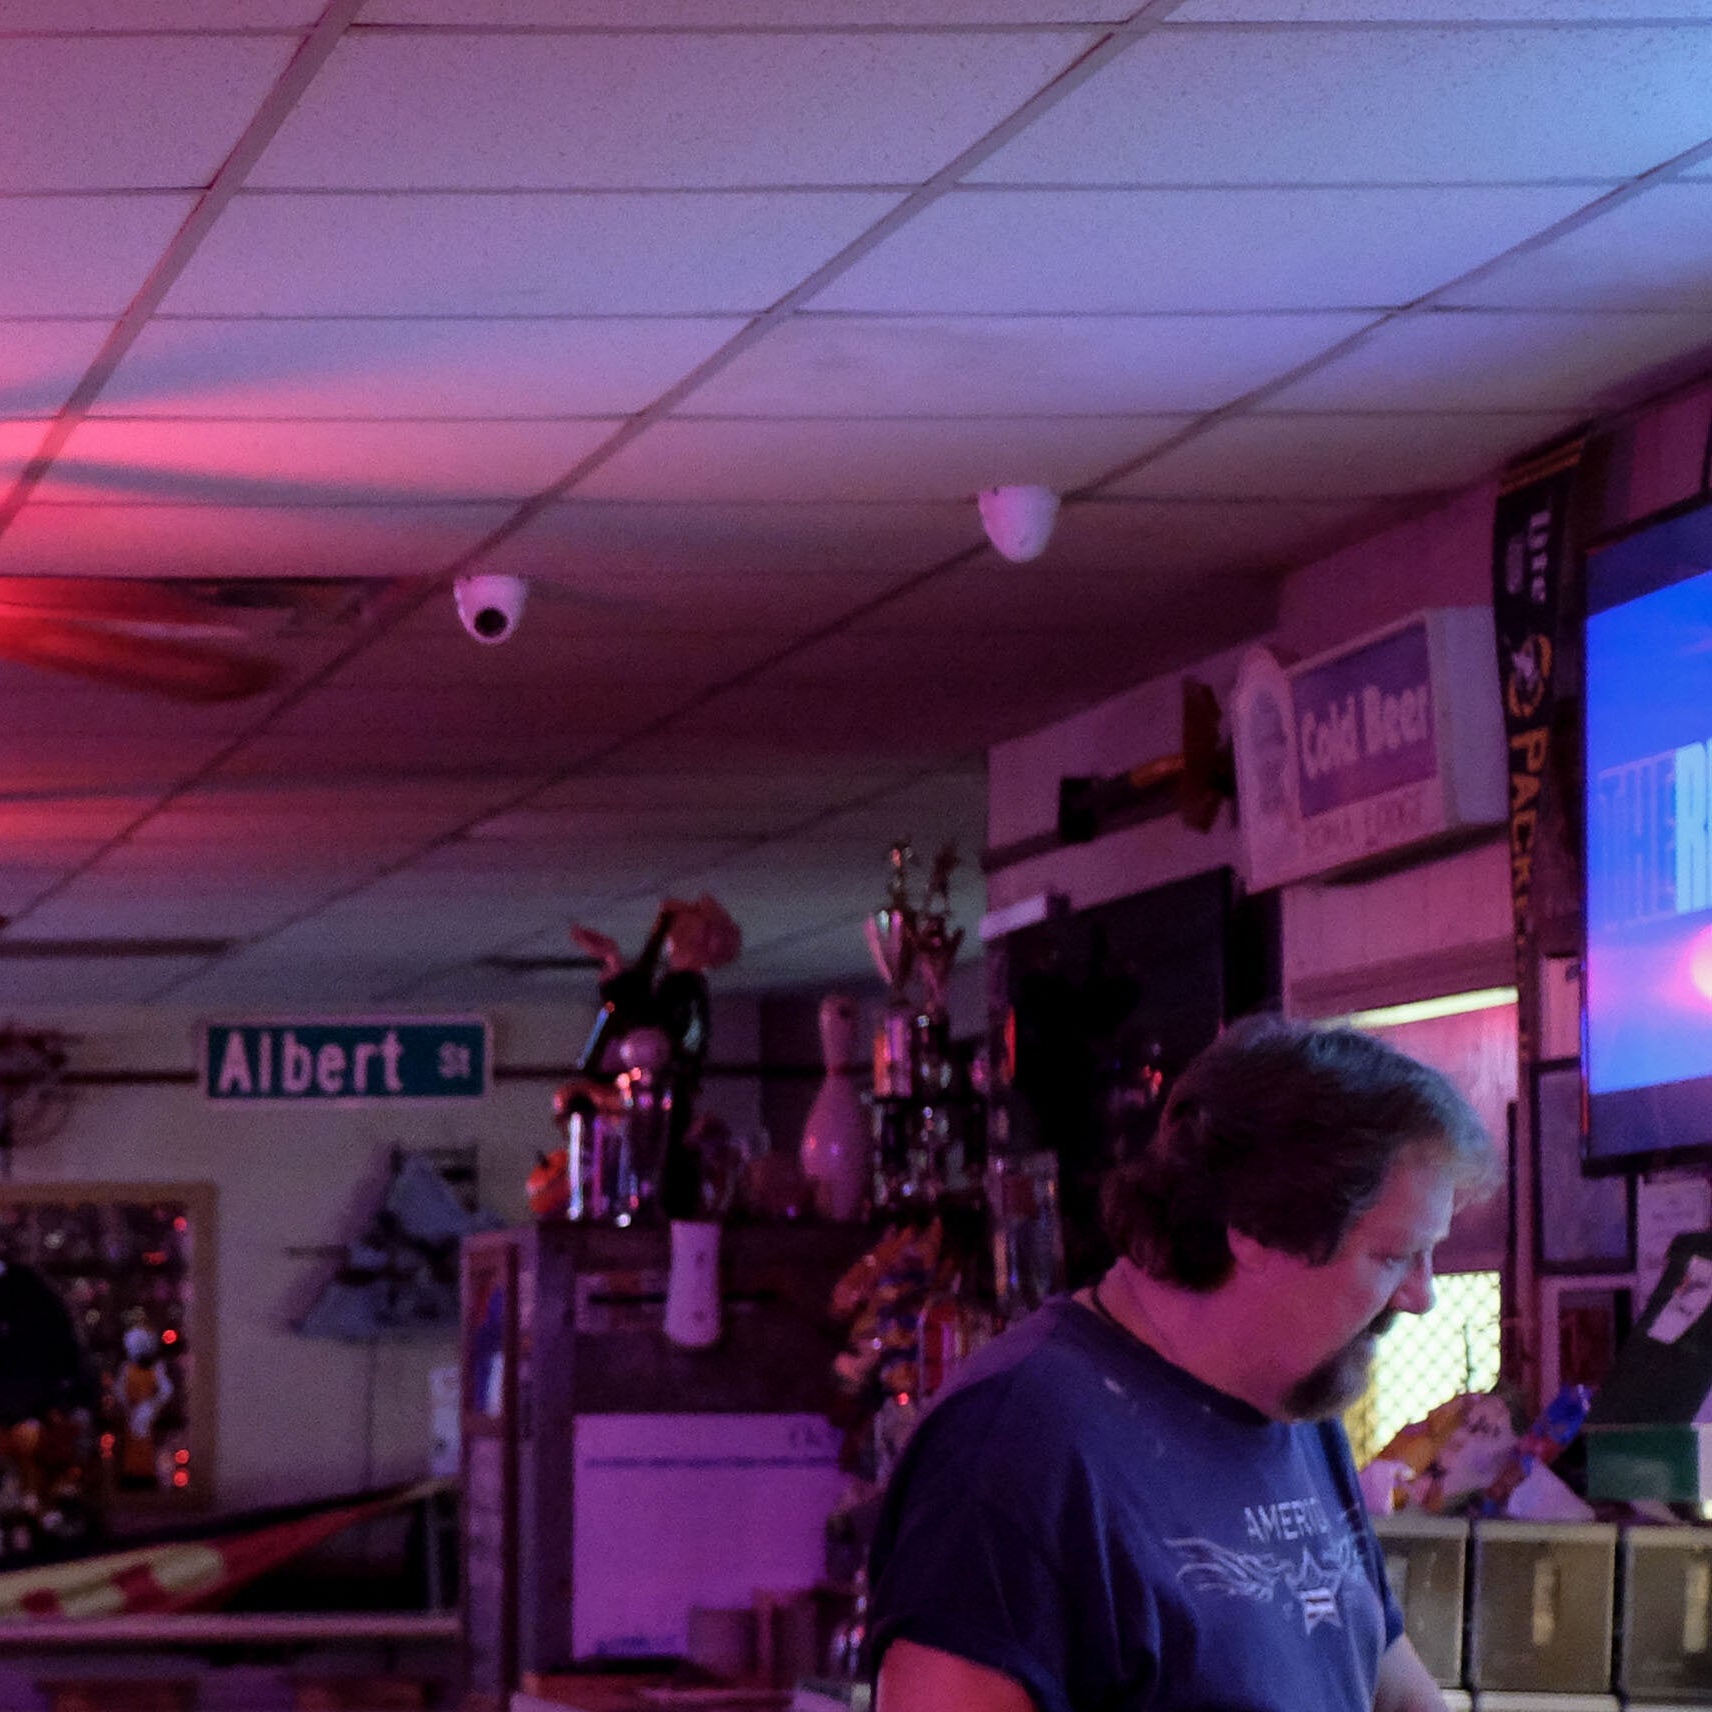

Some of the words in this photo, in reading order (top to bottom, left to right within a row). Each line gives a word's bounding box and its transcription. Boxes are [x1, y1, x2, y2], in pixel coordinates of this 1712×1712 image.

[1300, 690, 1358, 780] Cold
[1361, 683, 1429, 755] Beer
[216, 1029, 405, 1094] Albert
